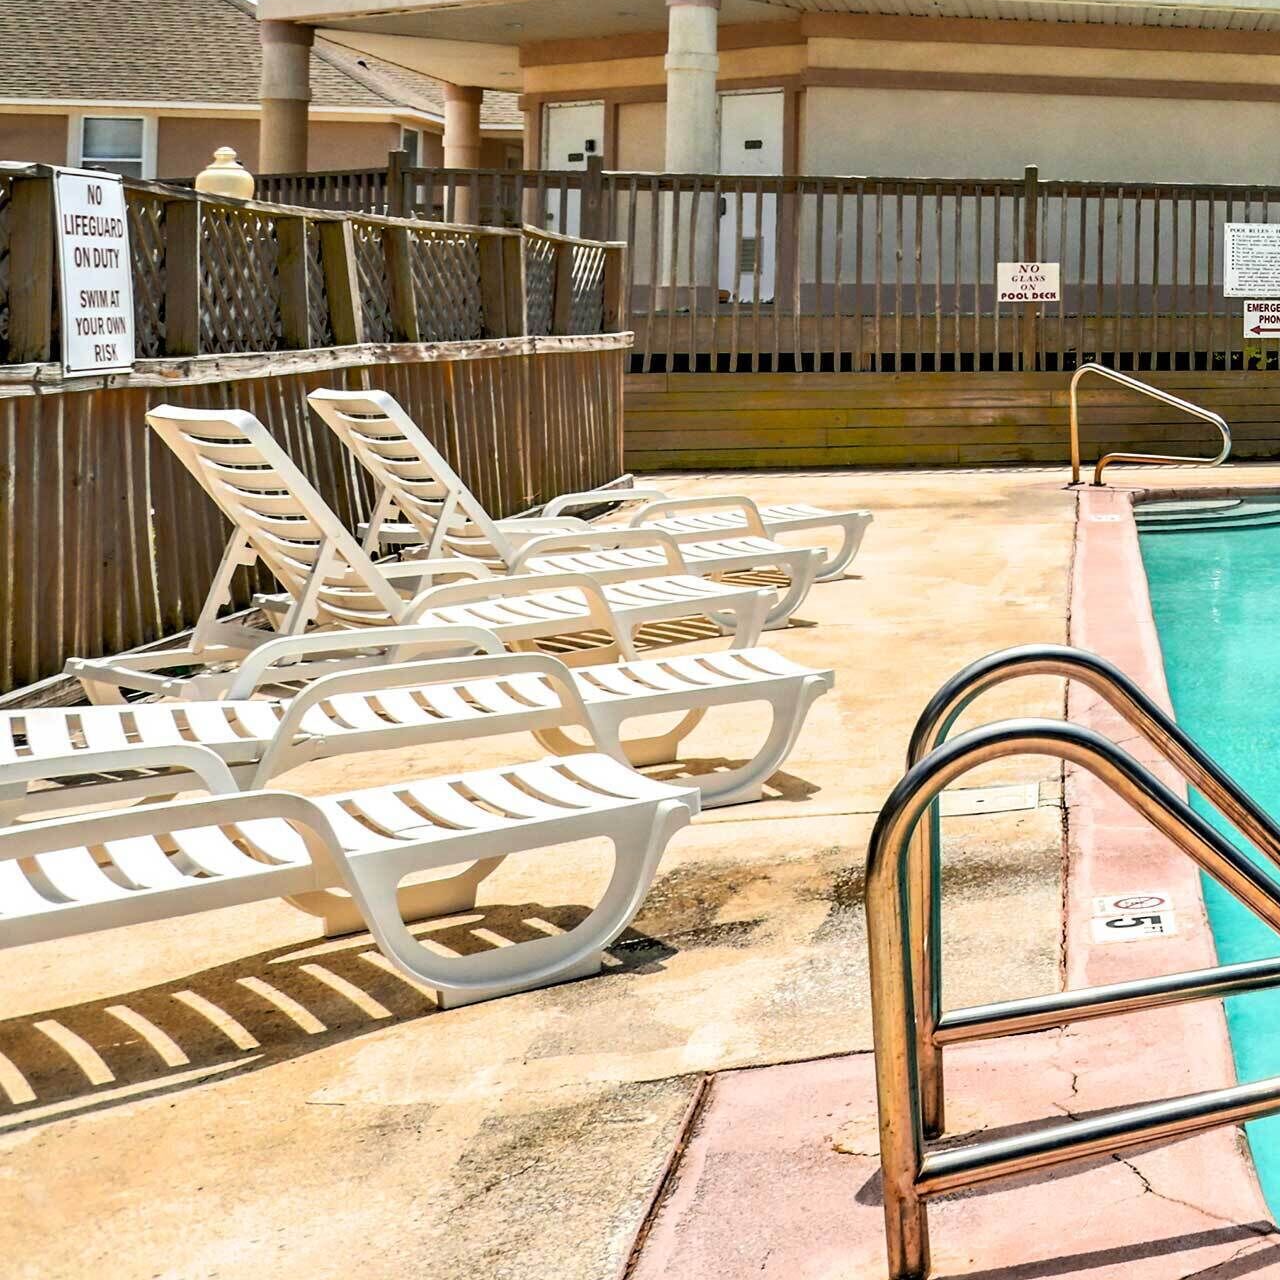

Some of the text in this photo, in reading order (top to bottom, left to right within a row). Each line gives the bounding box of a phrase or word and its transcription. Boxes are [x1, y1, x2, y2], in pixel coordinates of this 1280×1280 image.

[87, 184, 103, 206] NO
[64, 214, 124, 238] LIFEGUARD
[74, 247, 120, 269] ON DUTY
[1018, 264, 1040, 273] NO
[80, 290, 120, 309] SWIM AT
[1001, 292, 1028, 300] POOL
[75, 316, 127, 336] YOUR OWN
[94, 343, 117, 362] RISK
[1105, 915, 1162, 929] 5
